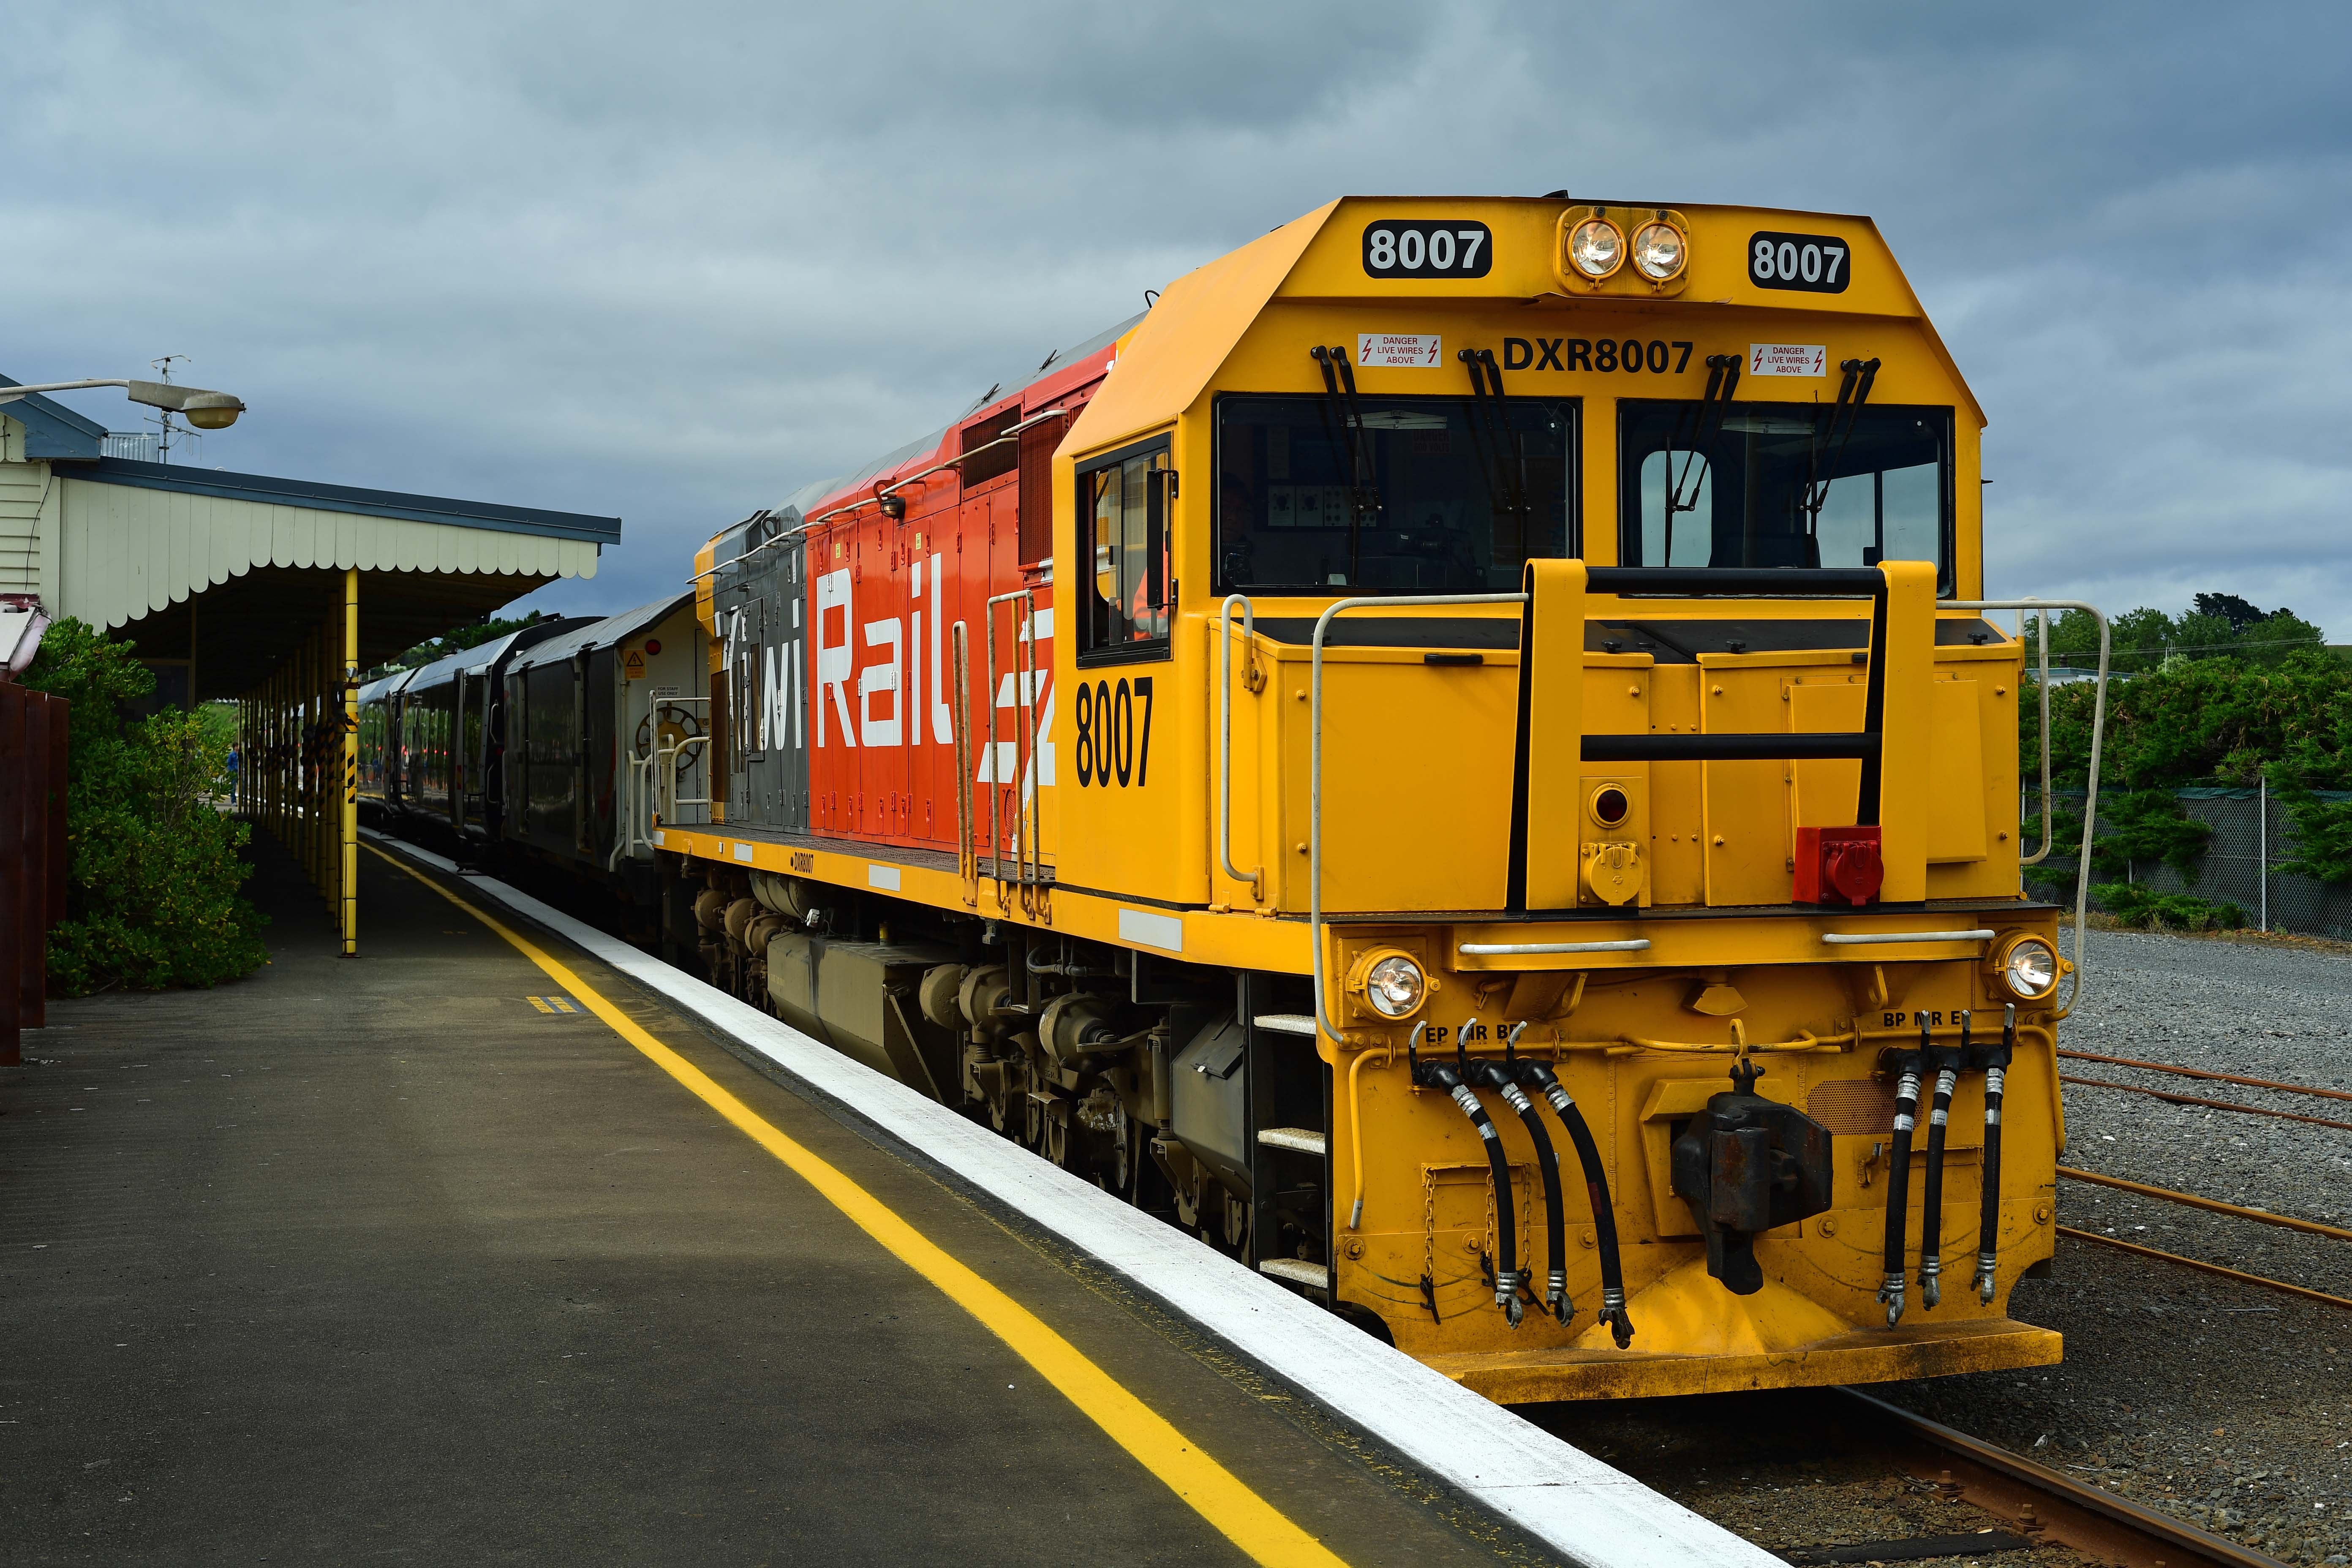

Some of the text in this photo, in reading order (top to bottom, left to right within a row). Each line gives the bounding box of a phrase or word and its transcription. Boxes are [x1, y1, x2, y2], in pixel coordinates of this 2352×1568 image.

[1369, 230, 1485, 270] 8007
[1753, 240, 1845, 284] 8007
[1503, 338, 1694, 374] DXR8007
[1773, 347, 1805, 355] DANGER
[1075, 676, 1153, 789] 8007
[794, 852, 814, 874] DXR8007
[1884, 1012, 1906, 1027] BP
[1425, 1027, 1448, 1043] EP
